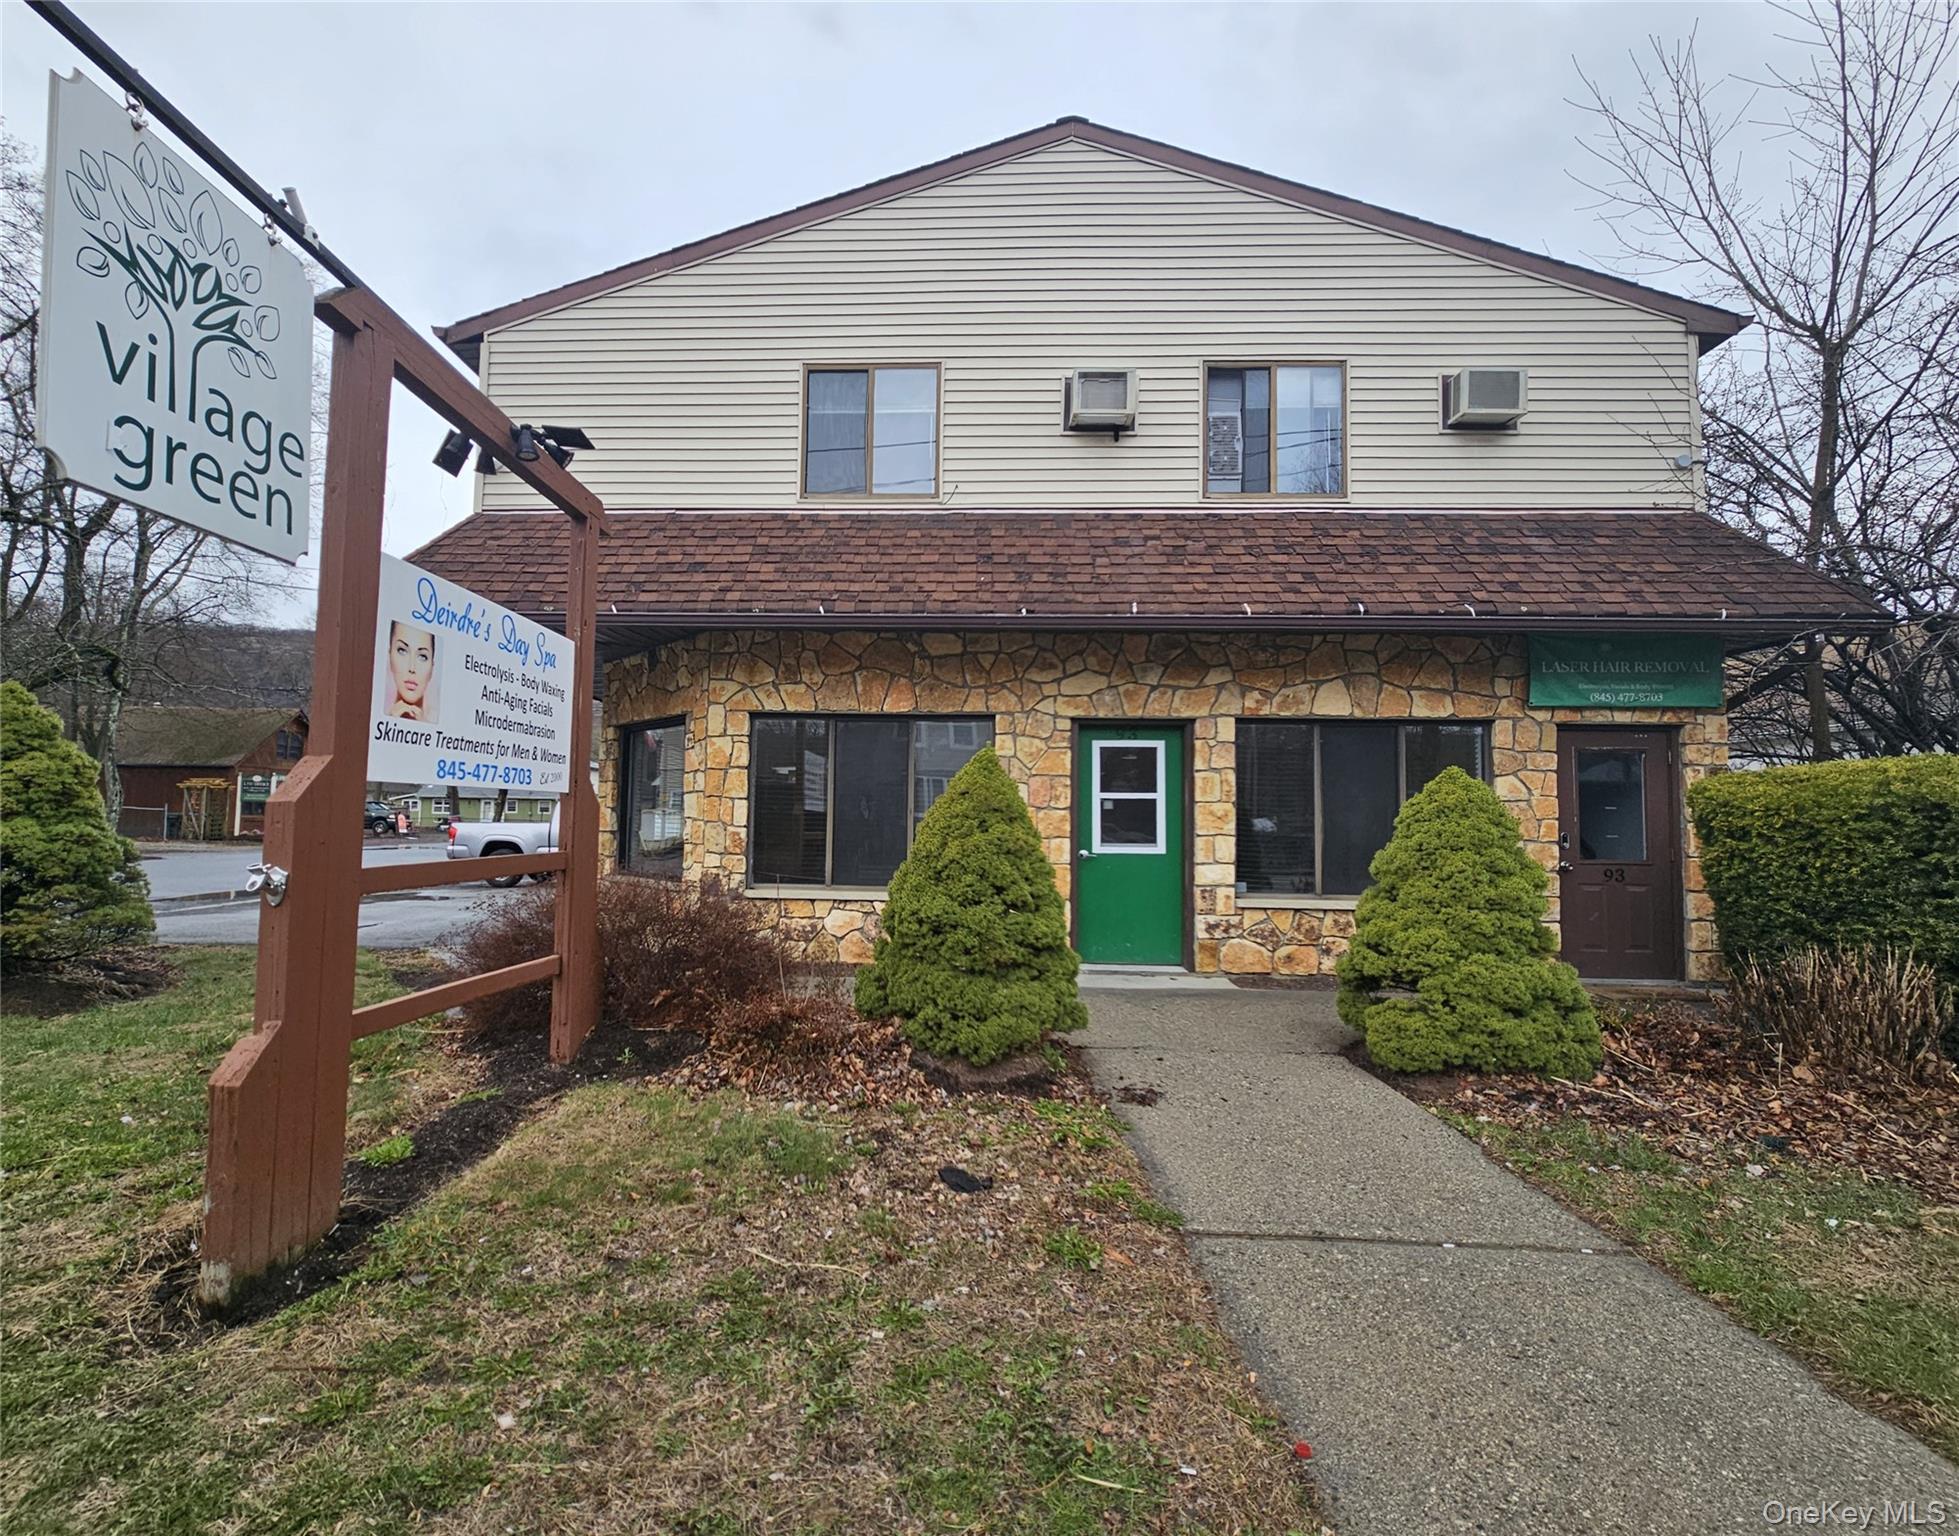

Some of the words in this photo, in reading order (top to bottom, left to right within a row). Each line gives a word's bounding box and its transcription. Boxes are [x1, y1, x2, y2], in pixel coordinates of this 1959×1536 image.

[95, 320, 305, 479] village
[111, 414, 293, 536] green
[411, 577, 492, 642] Deirdre's
[498, 615, 530, 666] Day
[535, 632, 557, 672] Spa
[465, 654, 515, 684] Electrolysis
[521, 673, 540, 694] Body
[541, 679, 565, 703] Waxing
[1541, 660, 1589, 673] LASER
[1592, 660, 1631, 673] HAIR
[1634, 660, 1710, 673] REMOVAL
[481, 684, 528, 714] Anti-Aging
[529, 698, 553, 717] Facials
[1589, 692, 1616, 704] (845)
[1617, 692, 1664, 703] 477-8703
[475, 708, 556, 740] Microdermabrasion
[375, 721, 432, 747] Skincare
[435, 731, 495, 756] Treatments
[495, 740, 510, 760] for
[511, 743, 530, 760] Men
[531, 747, 538, 761] &
[540, 747, 567, 764] Women
[436, 759, 533, 786] 845-477-8703
[1603, 868, 1625, 883] 93
